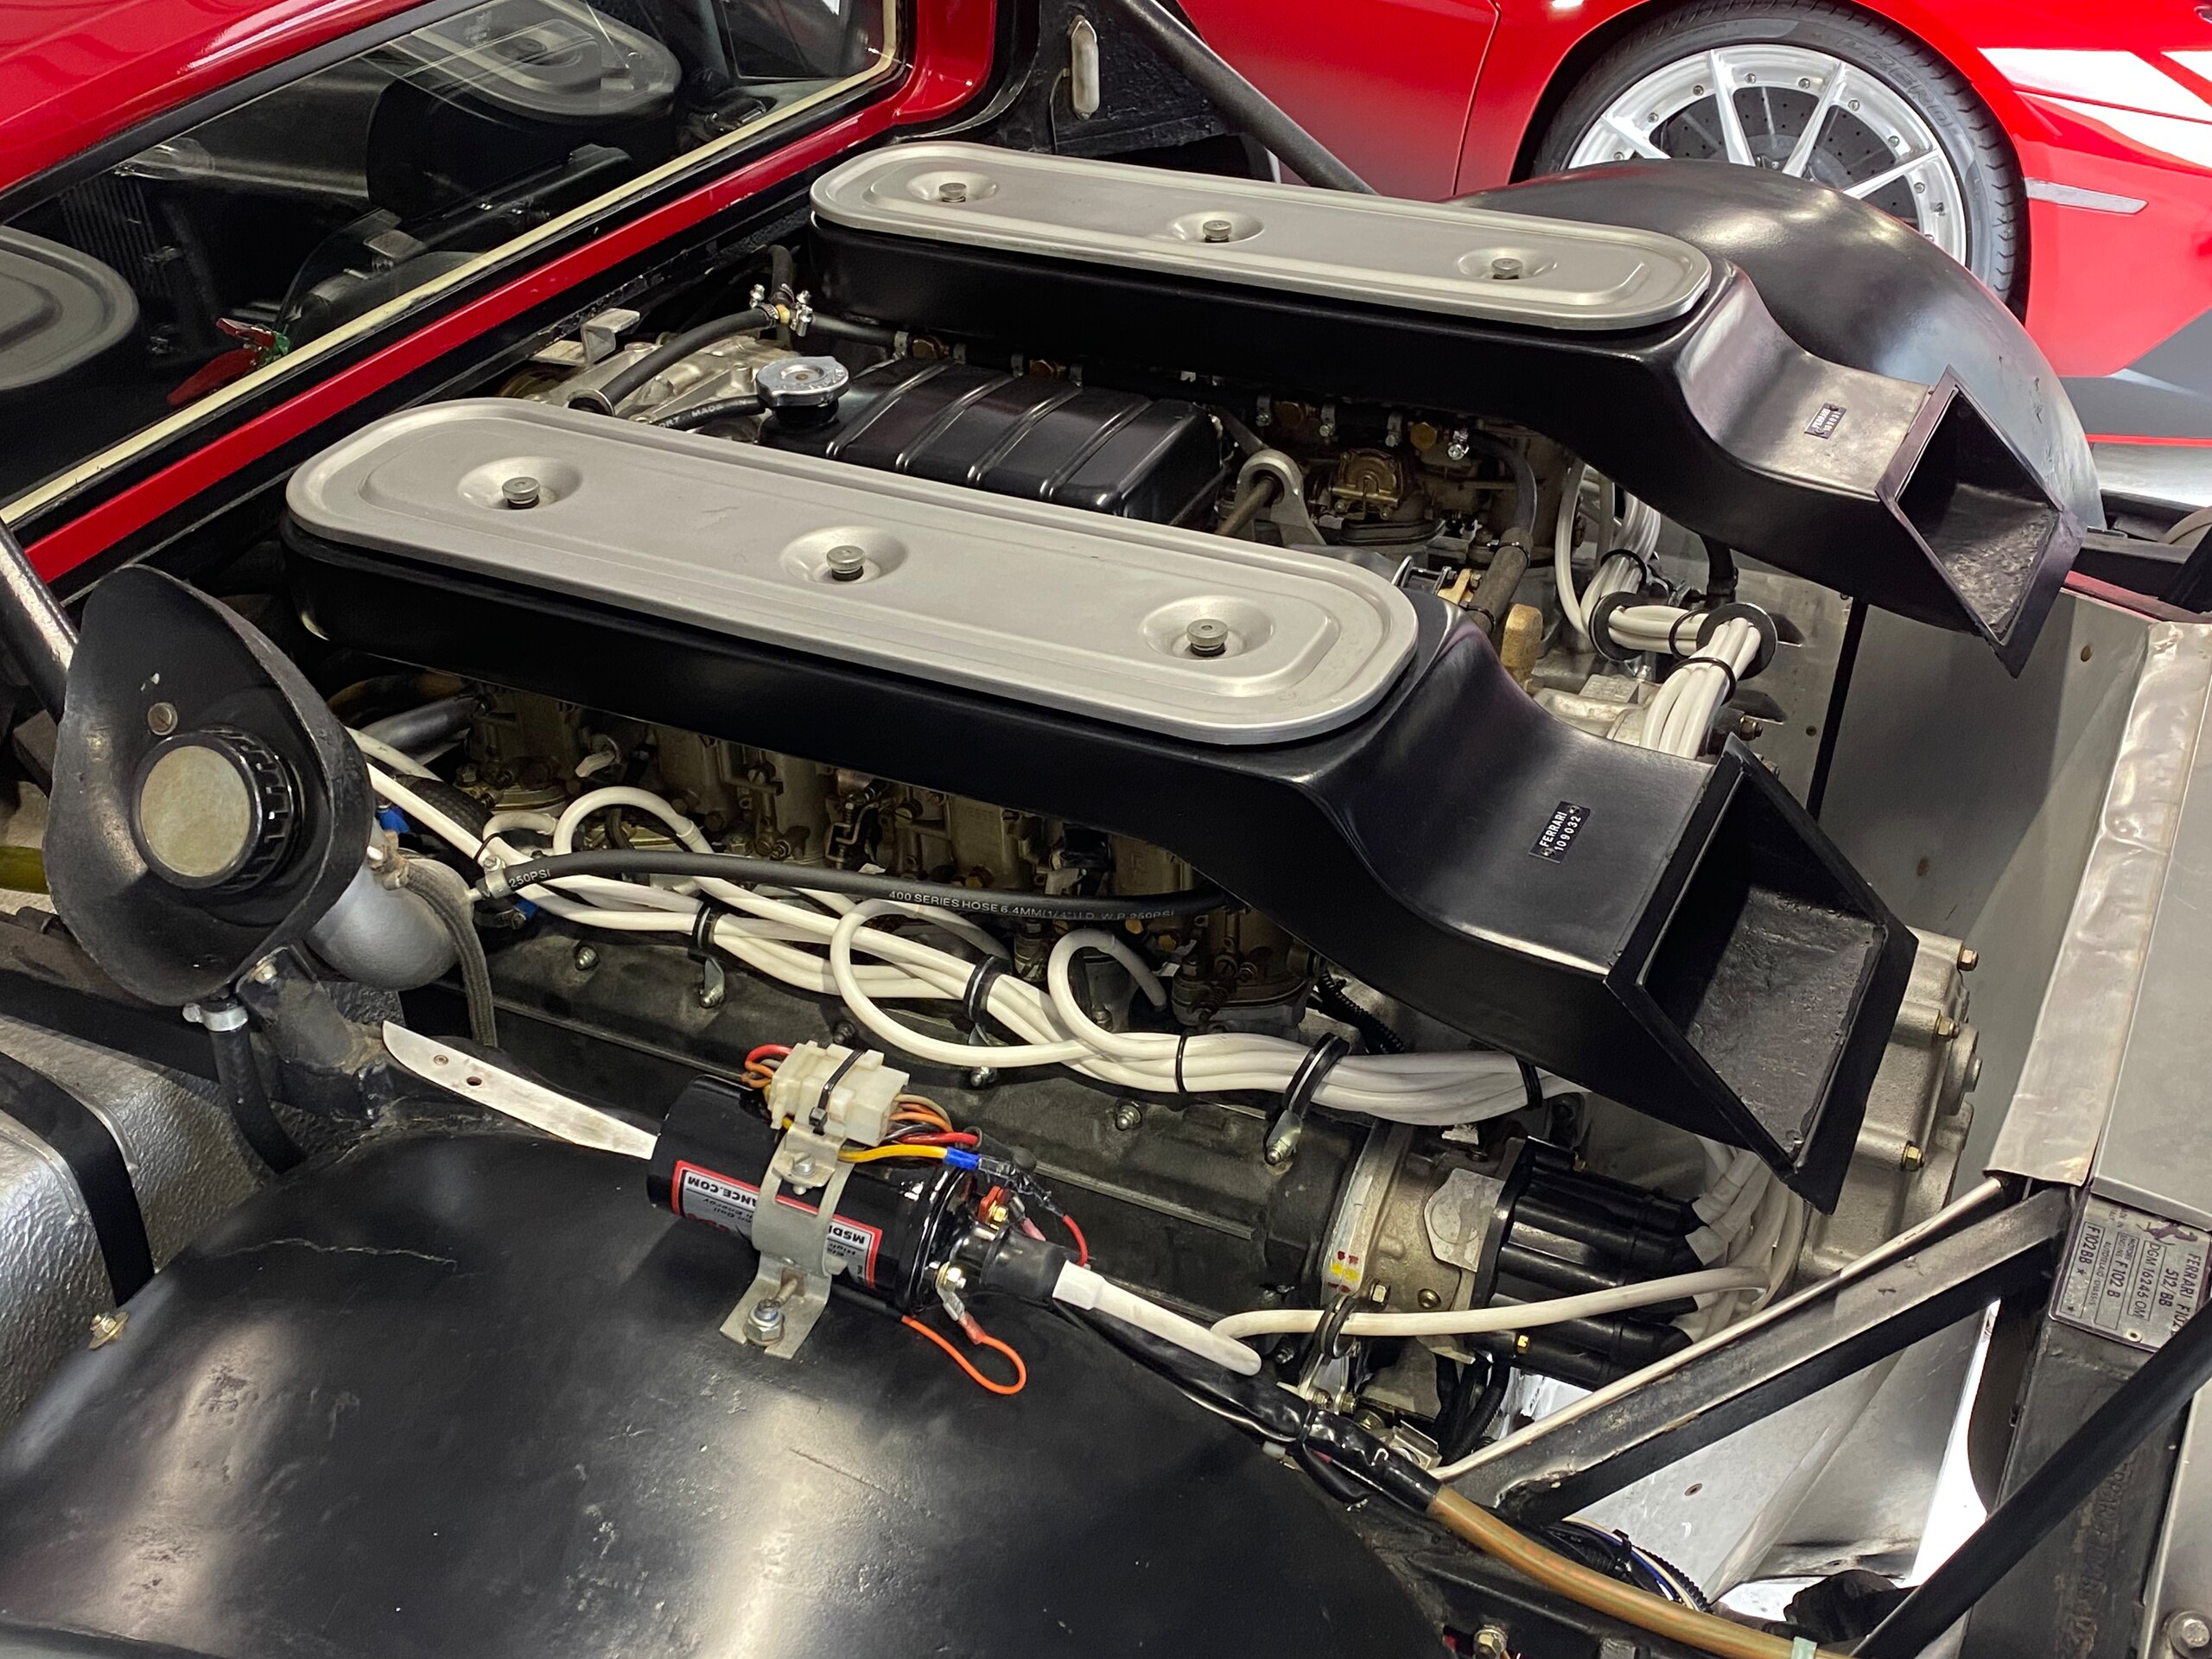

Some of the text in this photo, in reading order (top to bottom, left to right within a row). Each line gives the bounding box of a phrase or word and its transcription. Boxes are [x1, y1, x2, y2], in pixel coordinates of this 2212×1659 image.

[1539, 811, 1567, 848] FERRARI
[1554, 816, 1581, 851] 109032
[508, 868, 551, 888] 250PSI
[888, 890, 912, 902] 400
[913, 893, 960, 908] SERIES
[962, 900, 999, 912] HOSE
[2078, 1225, 2101, 1264] F102BB
[2145, 1243, 2161, 1267] DGM
[2158, 1268, 2179, 1307] 512/BB
[2179, 1253, 2202, 1299] FERRARI
[2107, 1289, 2121, 1299] B
[2133, 1300, 2147, 1319] OM
